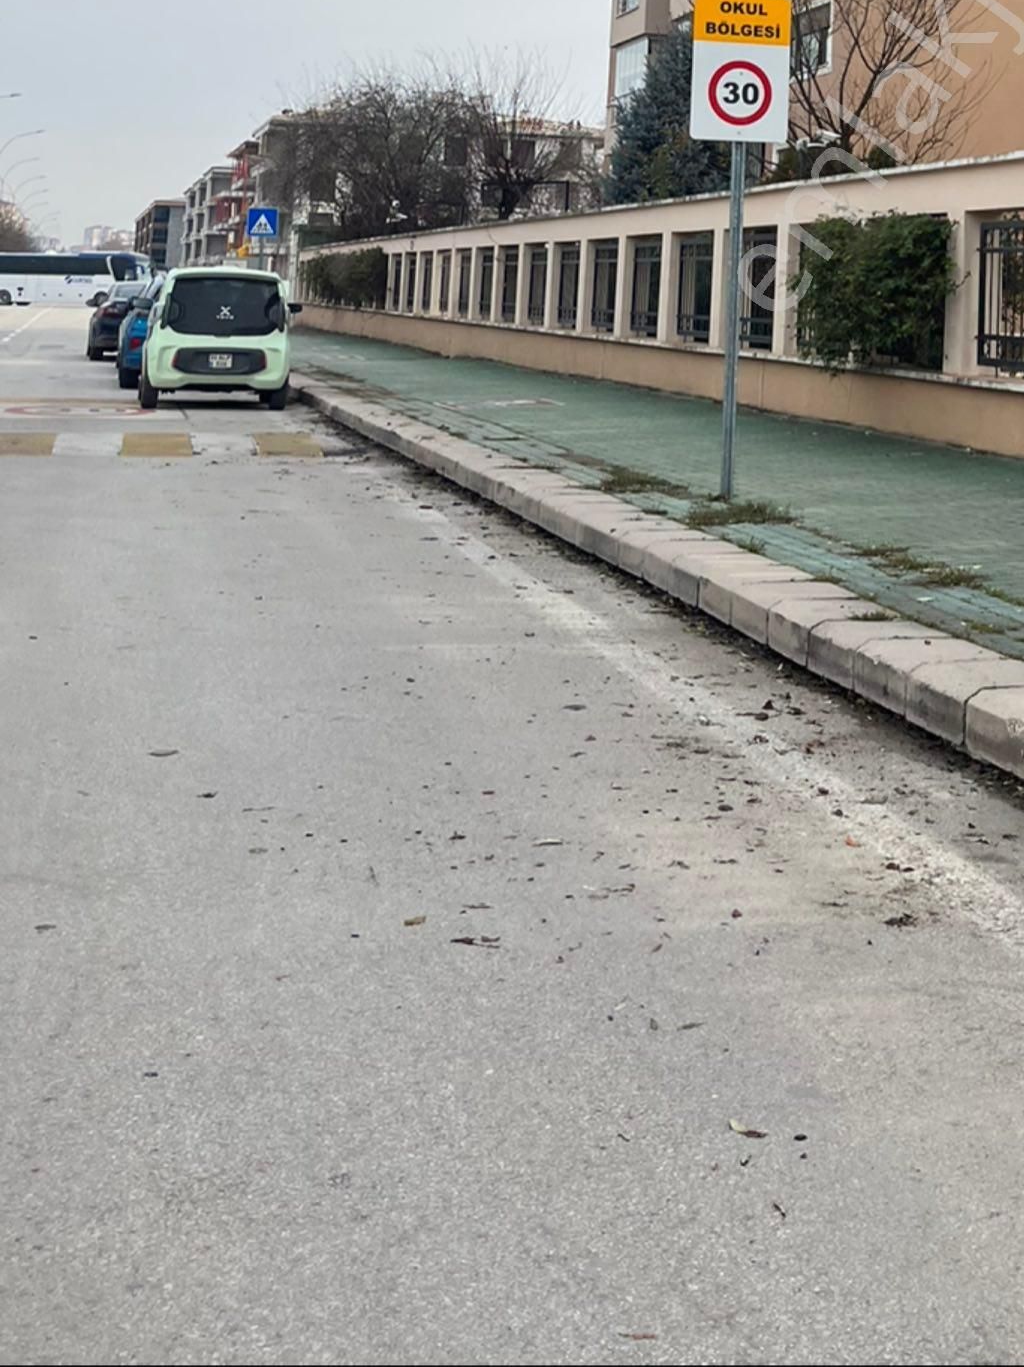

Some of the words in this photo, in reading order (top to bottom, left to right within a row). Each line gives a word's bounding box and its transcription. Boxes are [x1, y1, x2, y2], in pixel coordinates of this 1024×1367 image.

[720, 1, 768, 16] OKUL
[706, 21, 780, 39] BÖLGESİ
[722, 82, 760, 105] 30
